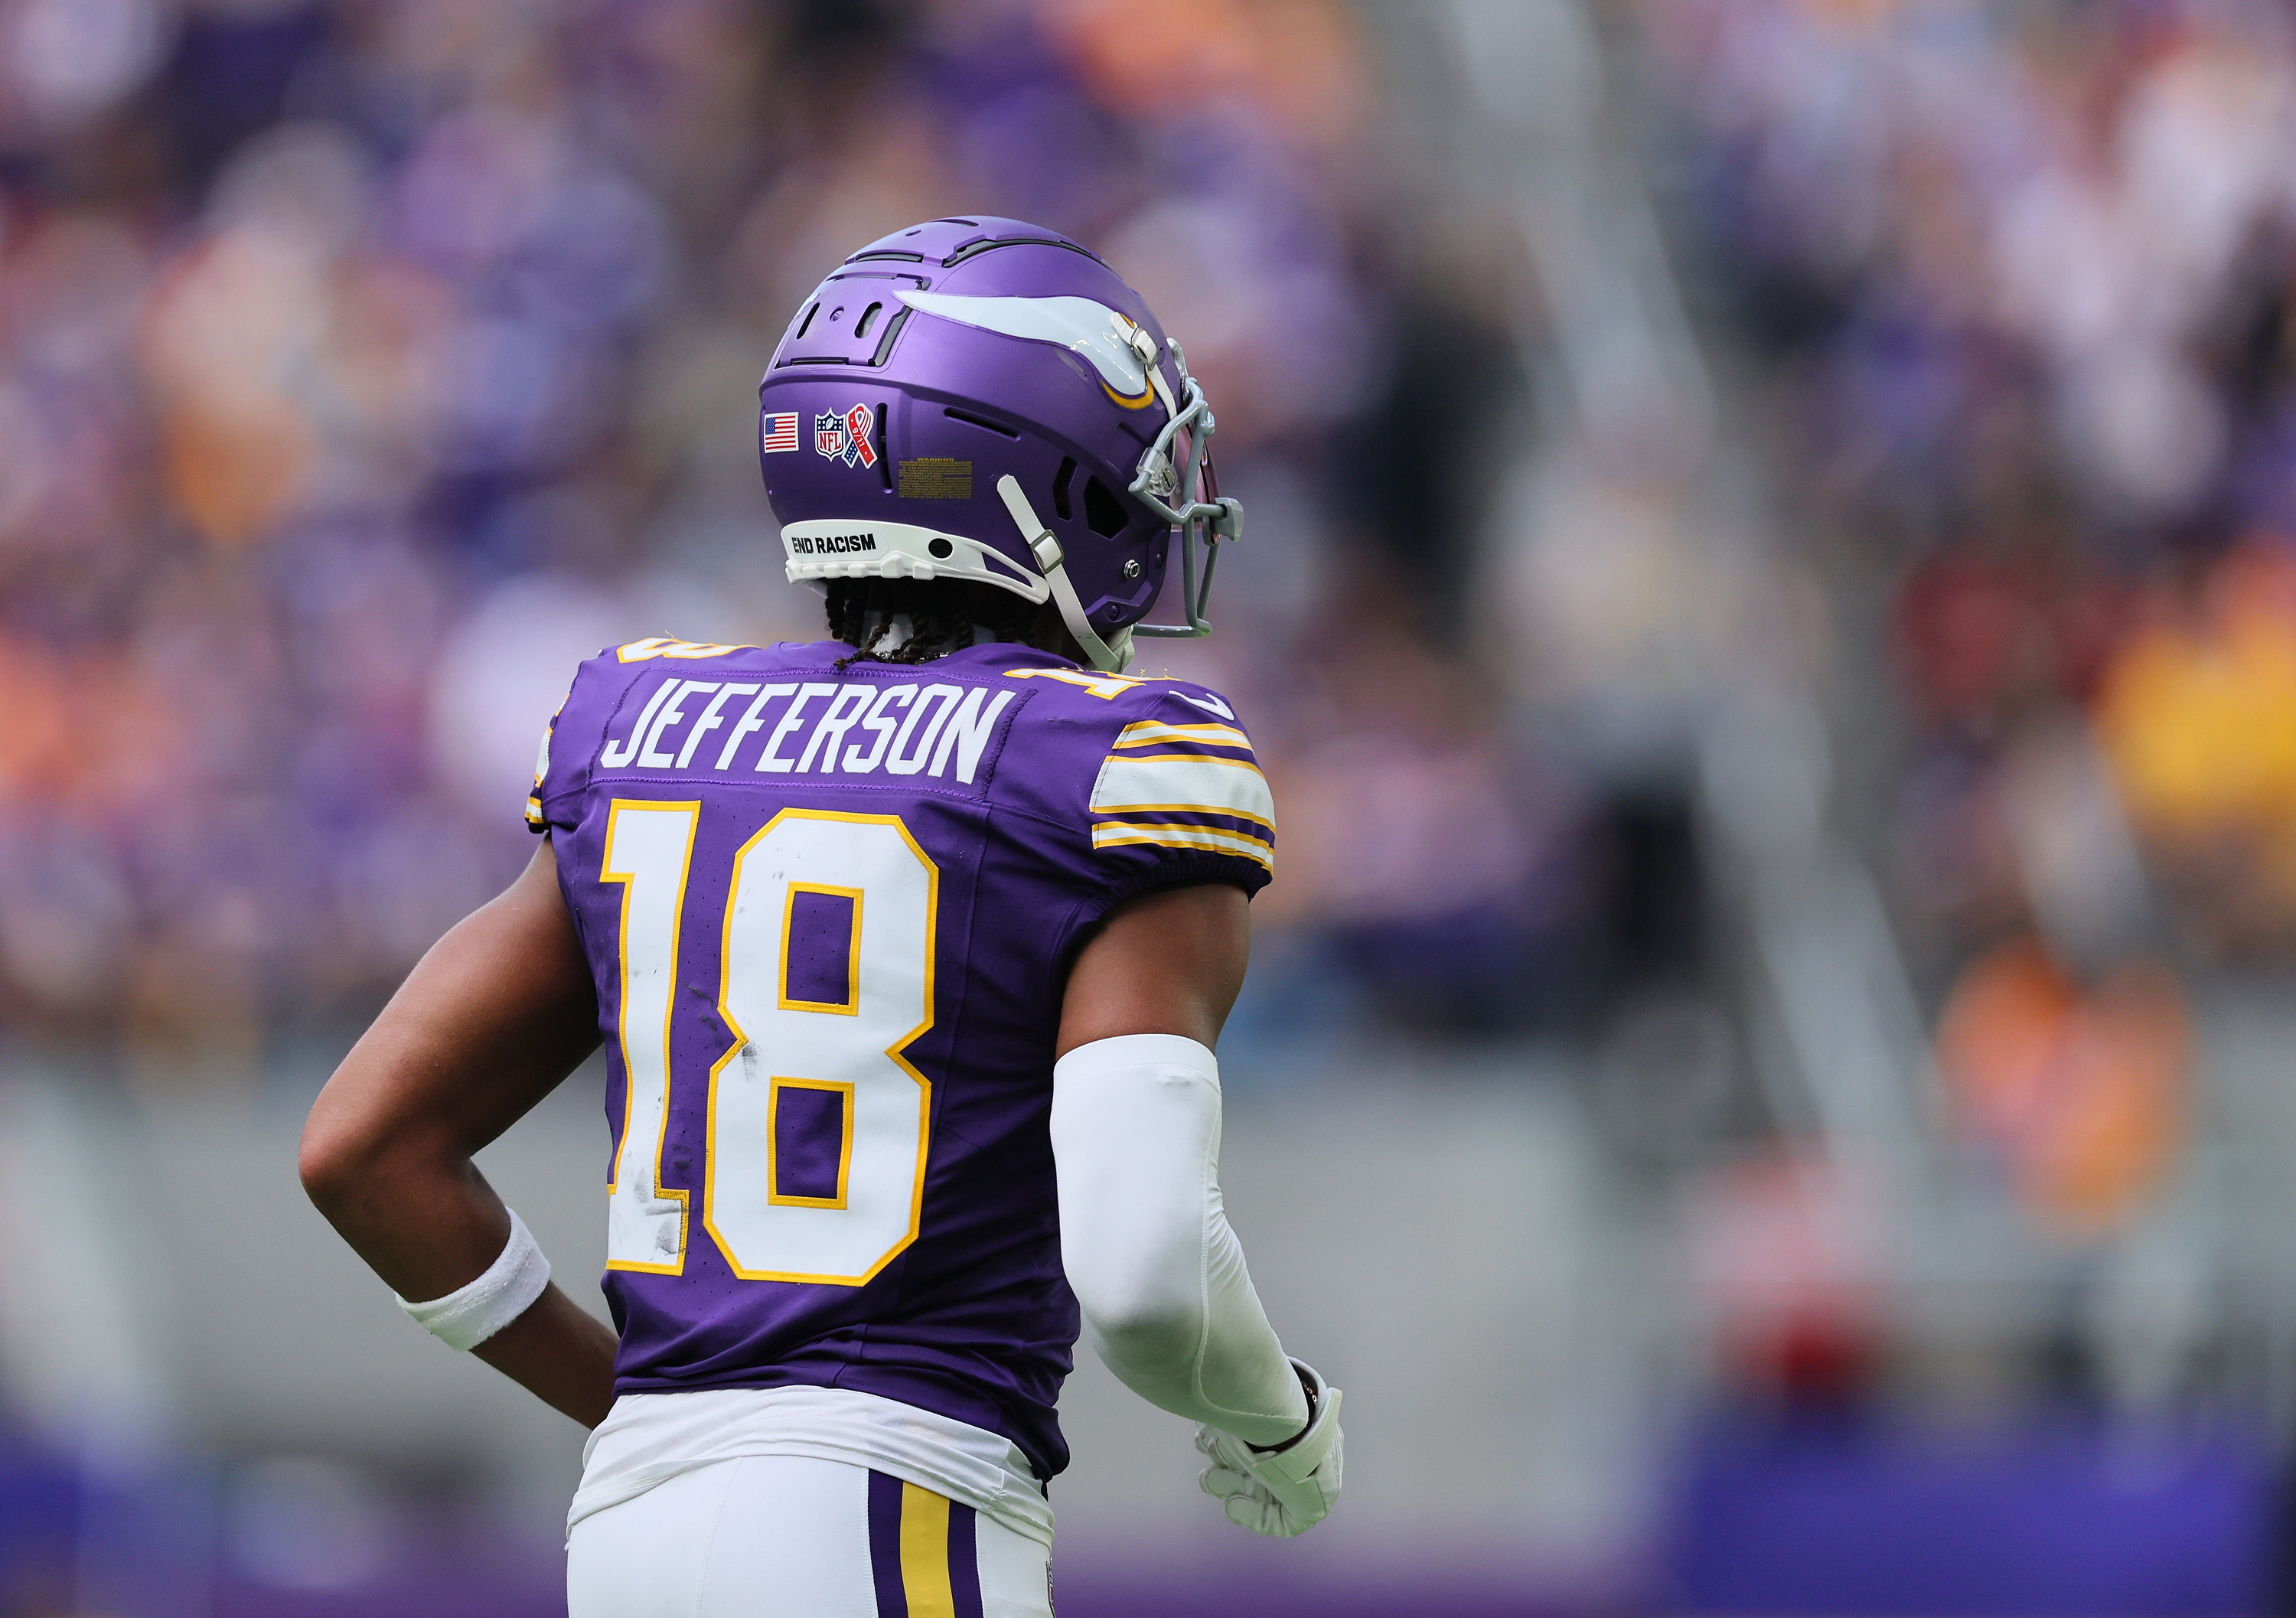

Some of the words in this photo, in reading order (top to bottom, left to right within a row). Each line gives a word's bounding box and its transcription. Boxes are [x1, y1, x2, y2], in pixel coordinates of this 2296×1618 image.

[819, 432, 841, 452] NFL
[852, 427, 866, 447] 9/11
[791, 537, 814, 554] END
[815, 533, 876, 553] RACISM
[599, 678, 1017, 785] JEFFERSON
[600, 798, 939, 1287] 18
